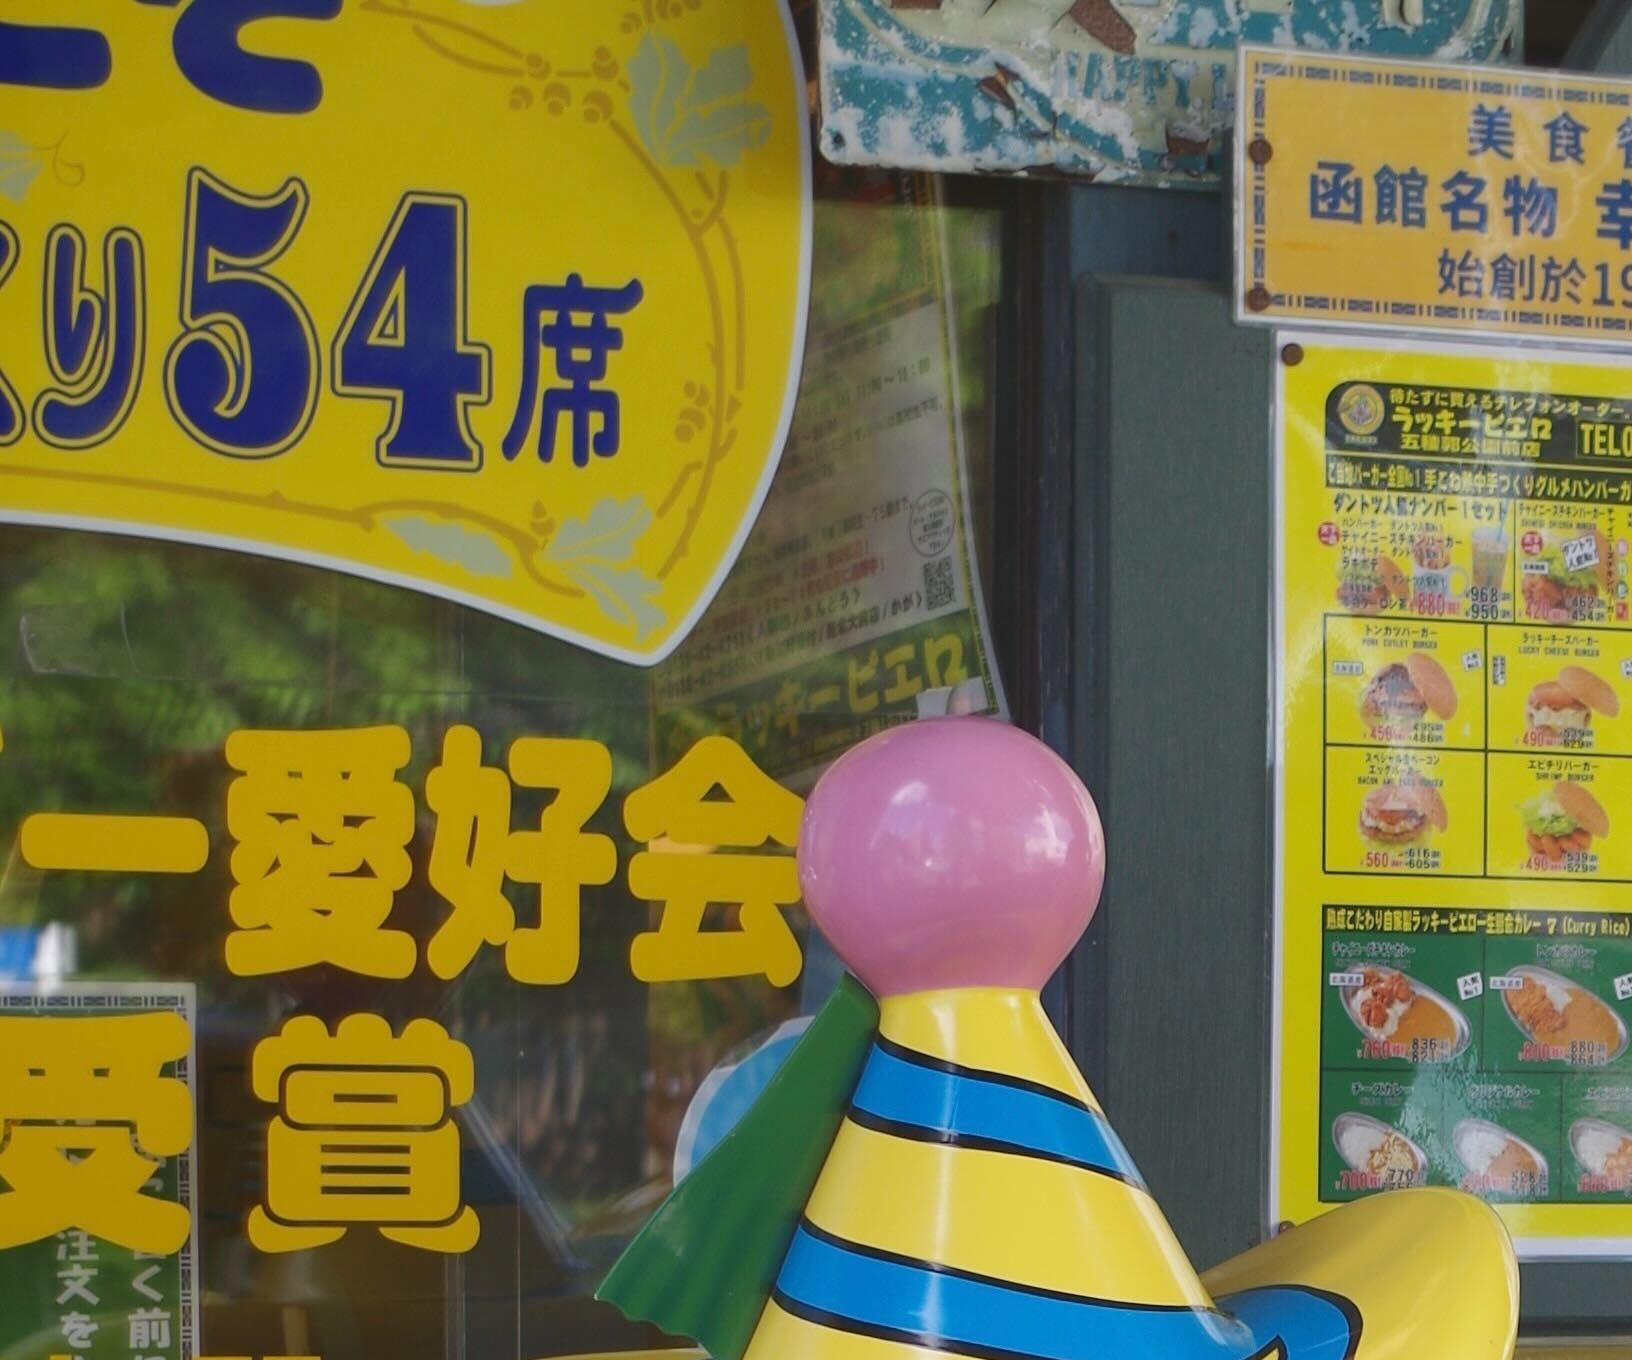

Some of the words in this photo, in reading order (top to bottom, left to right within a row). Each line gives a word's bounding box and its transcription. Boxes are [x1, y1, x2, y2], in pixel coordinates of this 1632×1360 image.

[1308, 160, 1560, 239] 函館名物
[0, 166, 644, 472] り54席
